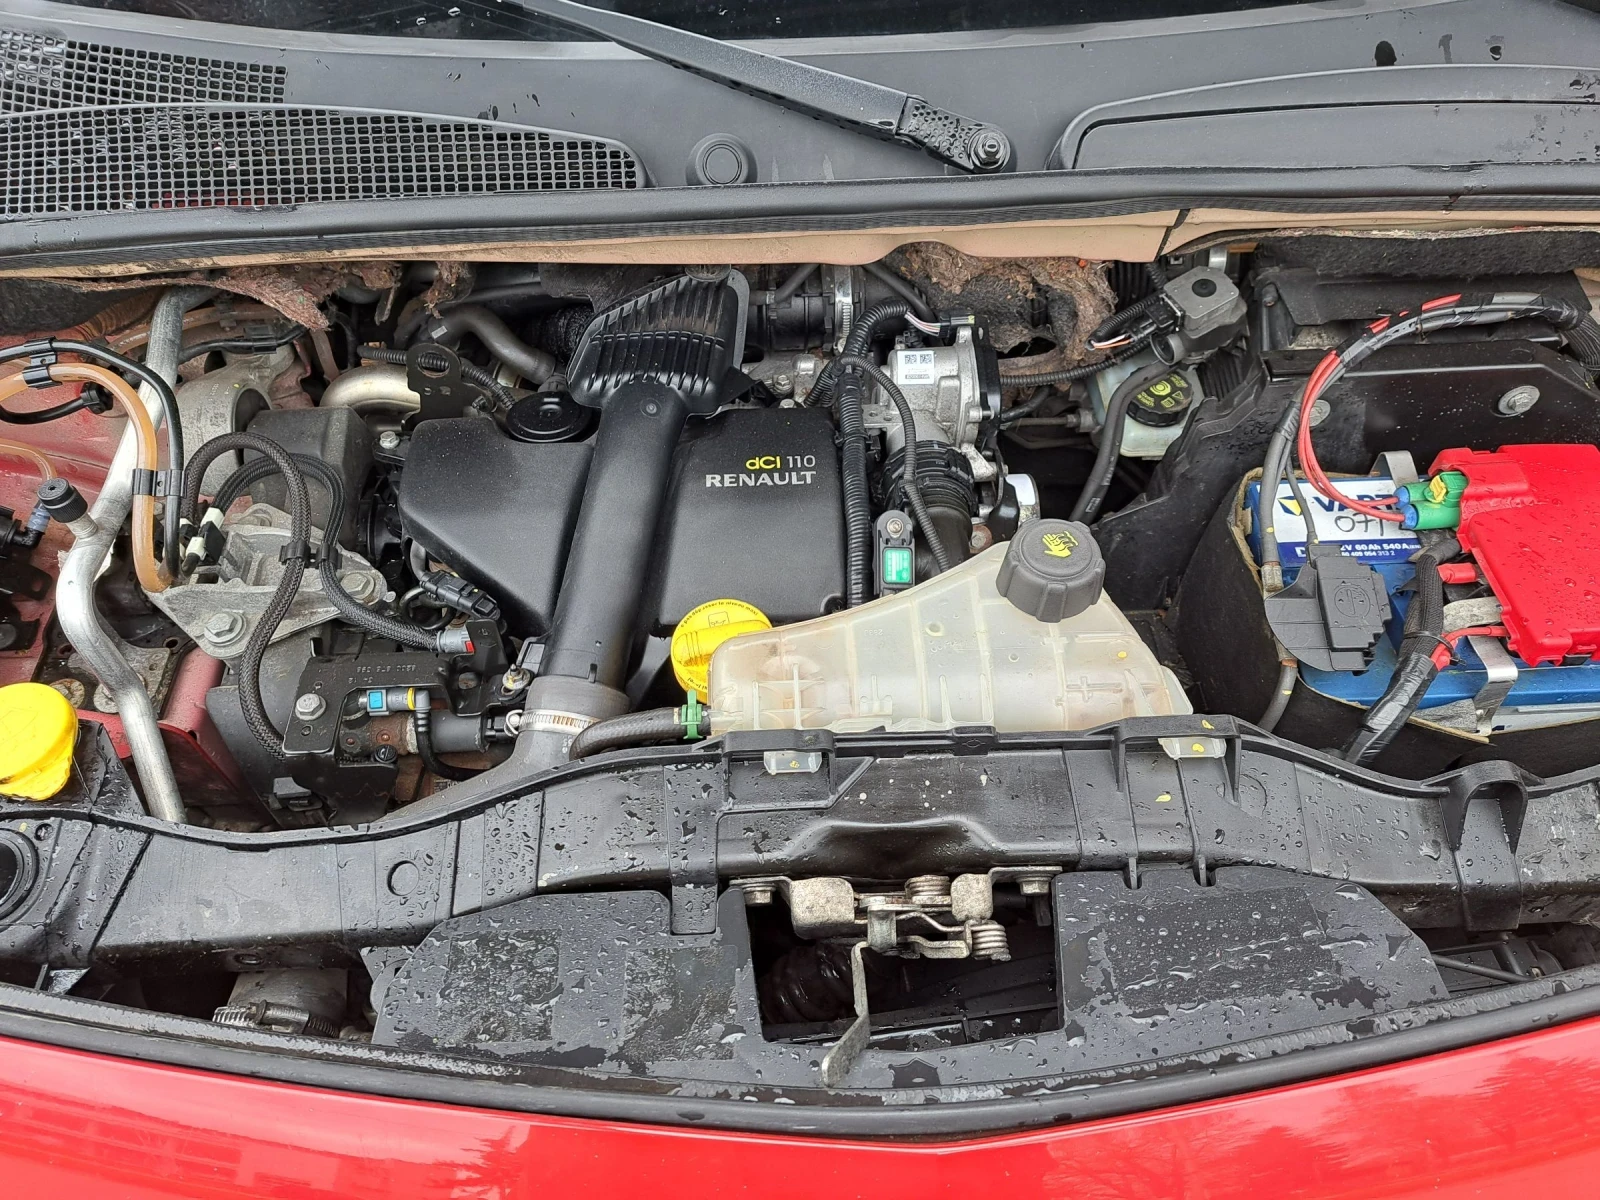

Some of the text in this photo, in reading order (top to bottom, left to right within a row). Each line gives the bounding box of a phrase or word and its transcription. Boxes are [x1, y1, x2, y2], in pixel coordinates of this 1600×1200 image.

[787, 455, 816, 468] 110
[705, 471, 816, 487] RENAULT
[1312, 494, 1402, 512] VRT
